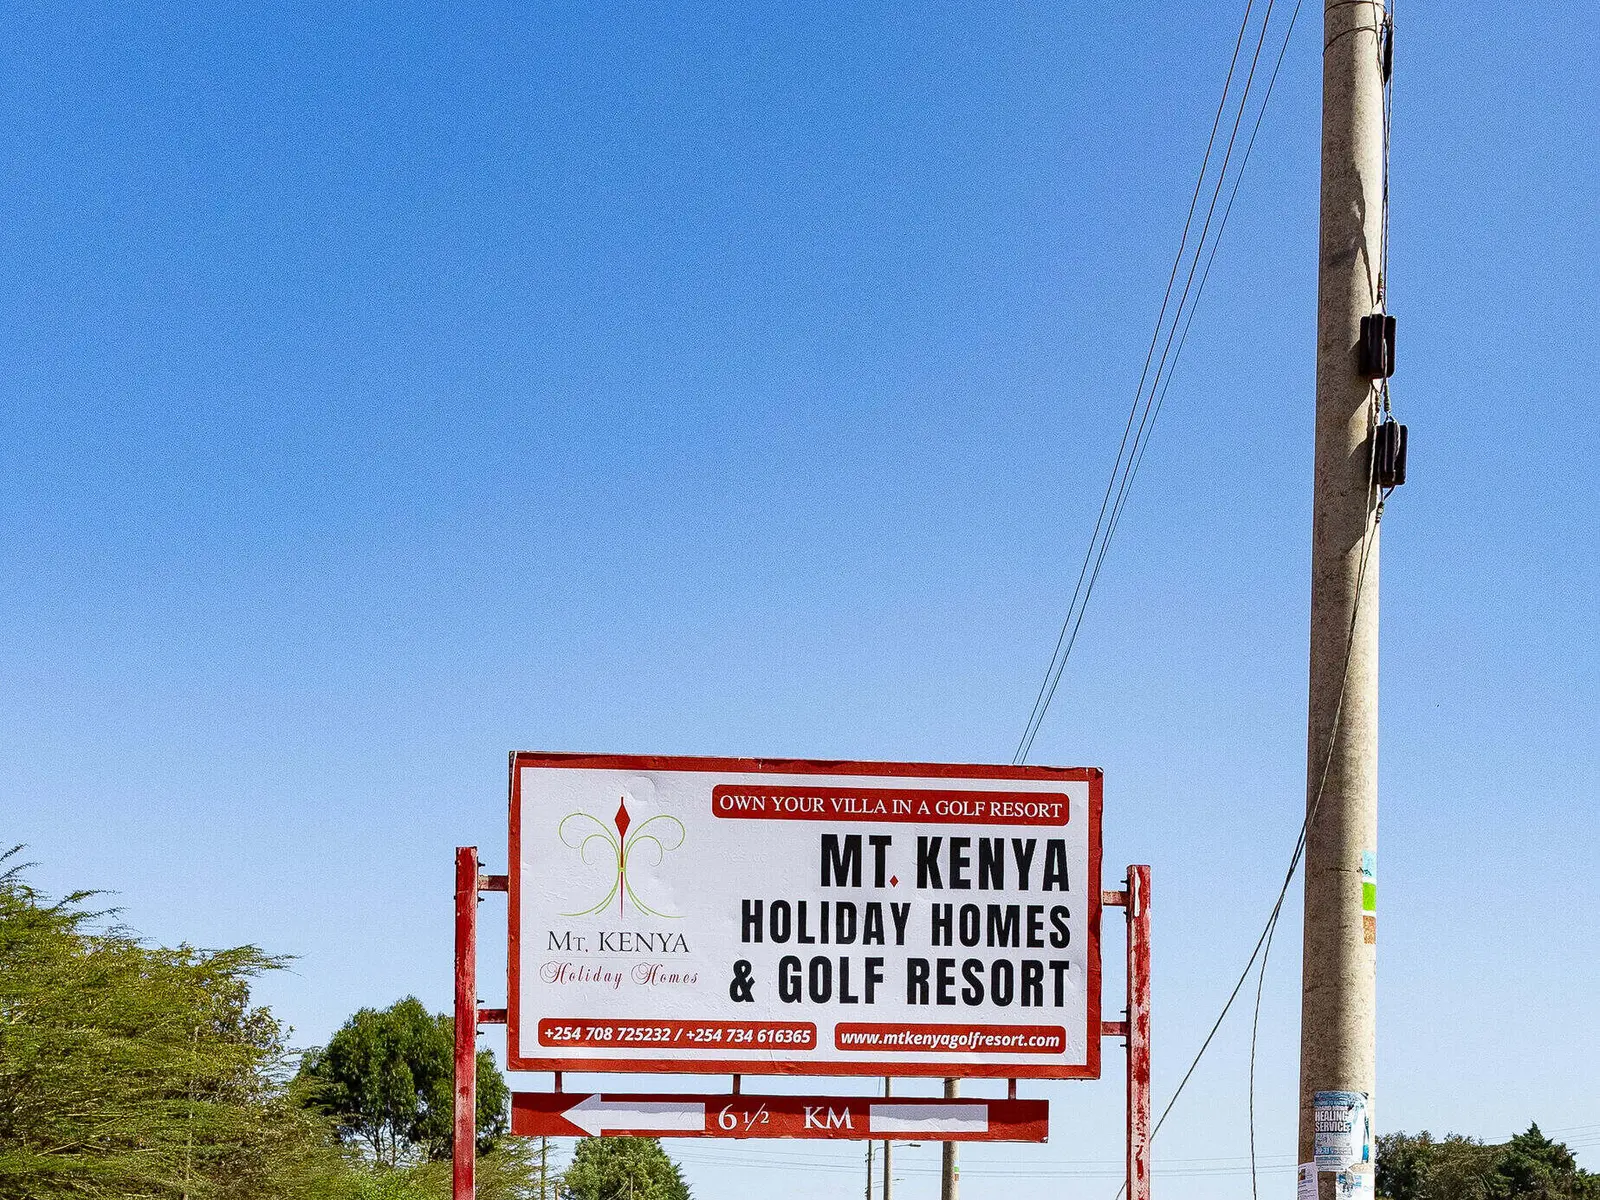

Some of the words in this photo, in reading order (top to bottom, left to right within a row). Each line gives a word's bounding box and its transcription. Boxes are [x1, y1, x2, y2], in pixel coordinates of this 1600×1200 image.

[719, 794, 766, 811] OWN
[771, 796, 825, 813] YOUR
[830, 797, 887, 815] VILLA
[892, 799, 912, 815] IN
[917, 800, 931, 815] A
[935, 800, 986, 817] GOLF
[990, 802, 1063, 818] RESORT
[820, 833, 899, 888] MT.
[916, 836, 1070, 892] KENYA
[741, 899, 912, 946] HOLIDAY
[931, 903, 1071, 949] HOMES
[598, 931, 691, 953] KENYA
[539, 960, 623, 990] Holiday
[631, 962, 699, 986] Homes
[729, 959, 756, 1004] &
[778, 955, 885, 1005] GOLF
[906, 957, 1070, 1008] RESORT
[544, 1026, 581, 1041] +254
[586, 1027, 613, 1041] 708
[616, 1027, 671, 1042] 725232
[685, 1028, 722, 1043] +254
[726, 1029, 753, 1043] 734
[757, 1029, 812, 1044] 616365
[841, 1031, 1060, 1051] www.mtkenyagolfresort.com
[803, 1106, 855, 1130] KM
